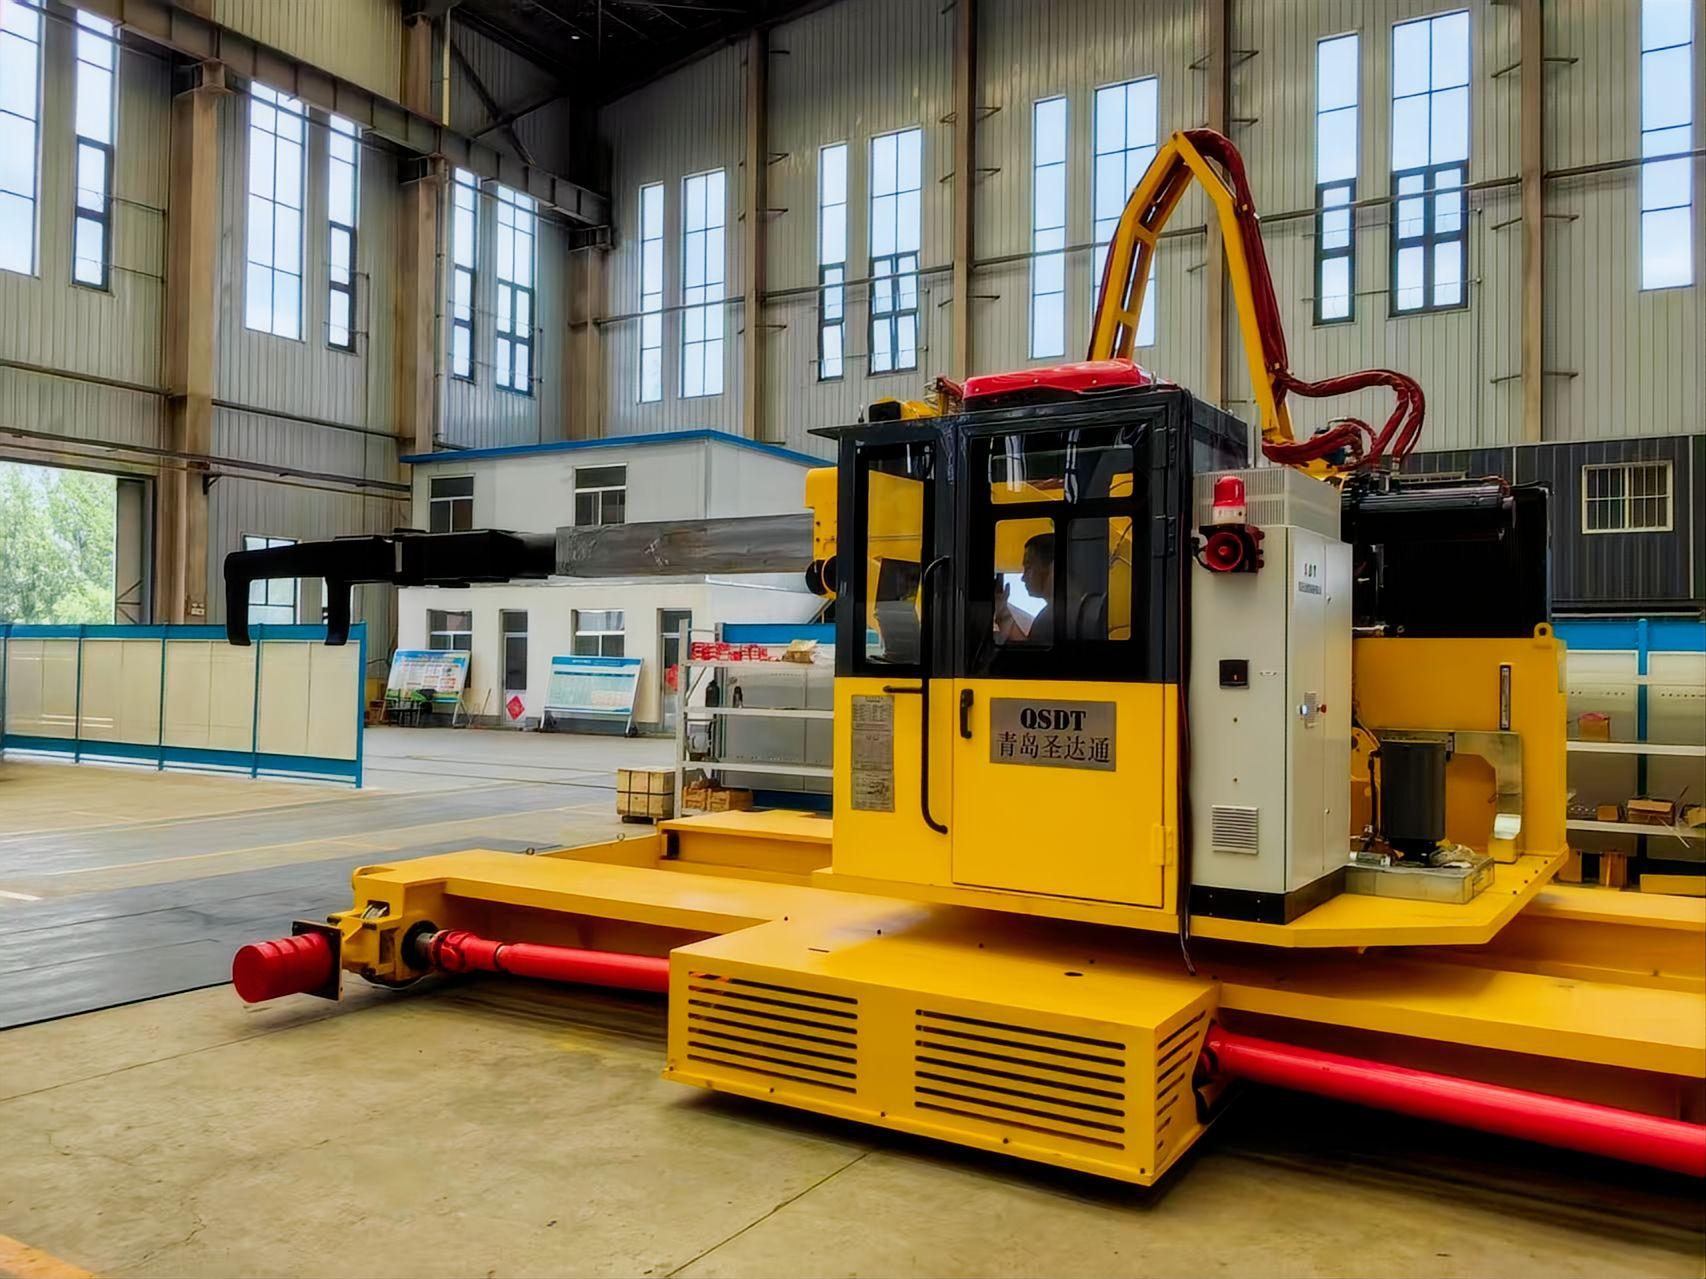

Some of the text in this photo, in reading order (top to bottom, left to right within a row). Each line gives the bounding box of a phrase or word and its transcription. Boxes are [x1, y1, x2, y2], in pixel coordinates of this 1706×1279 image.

[1020, 708, 1086, 731] QSDT
[997, 731, 1111, 763] 青岛圣达通
